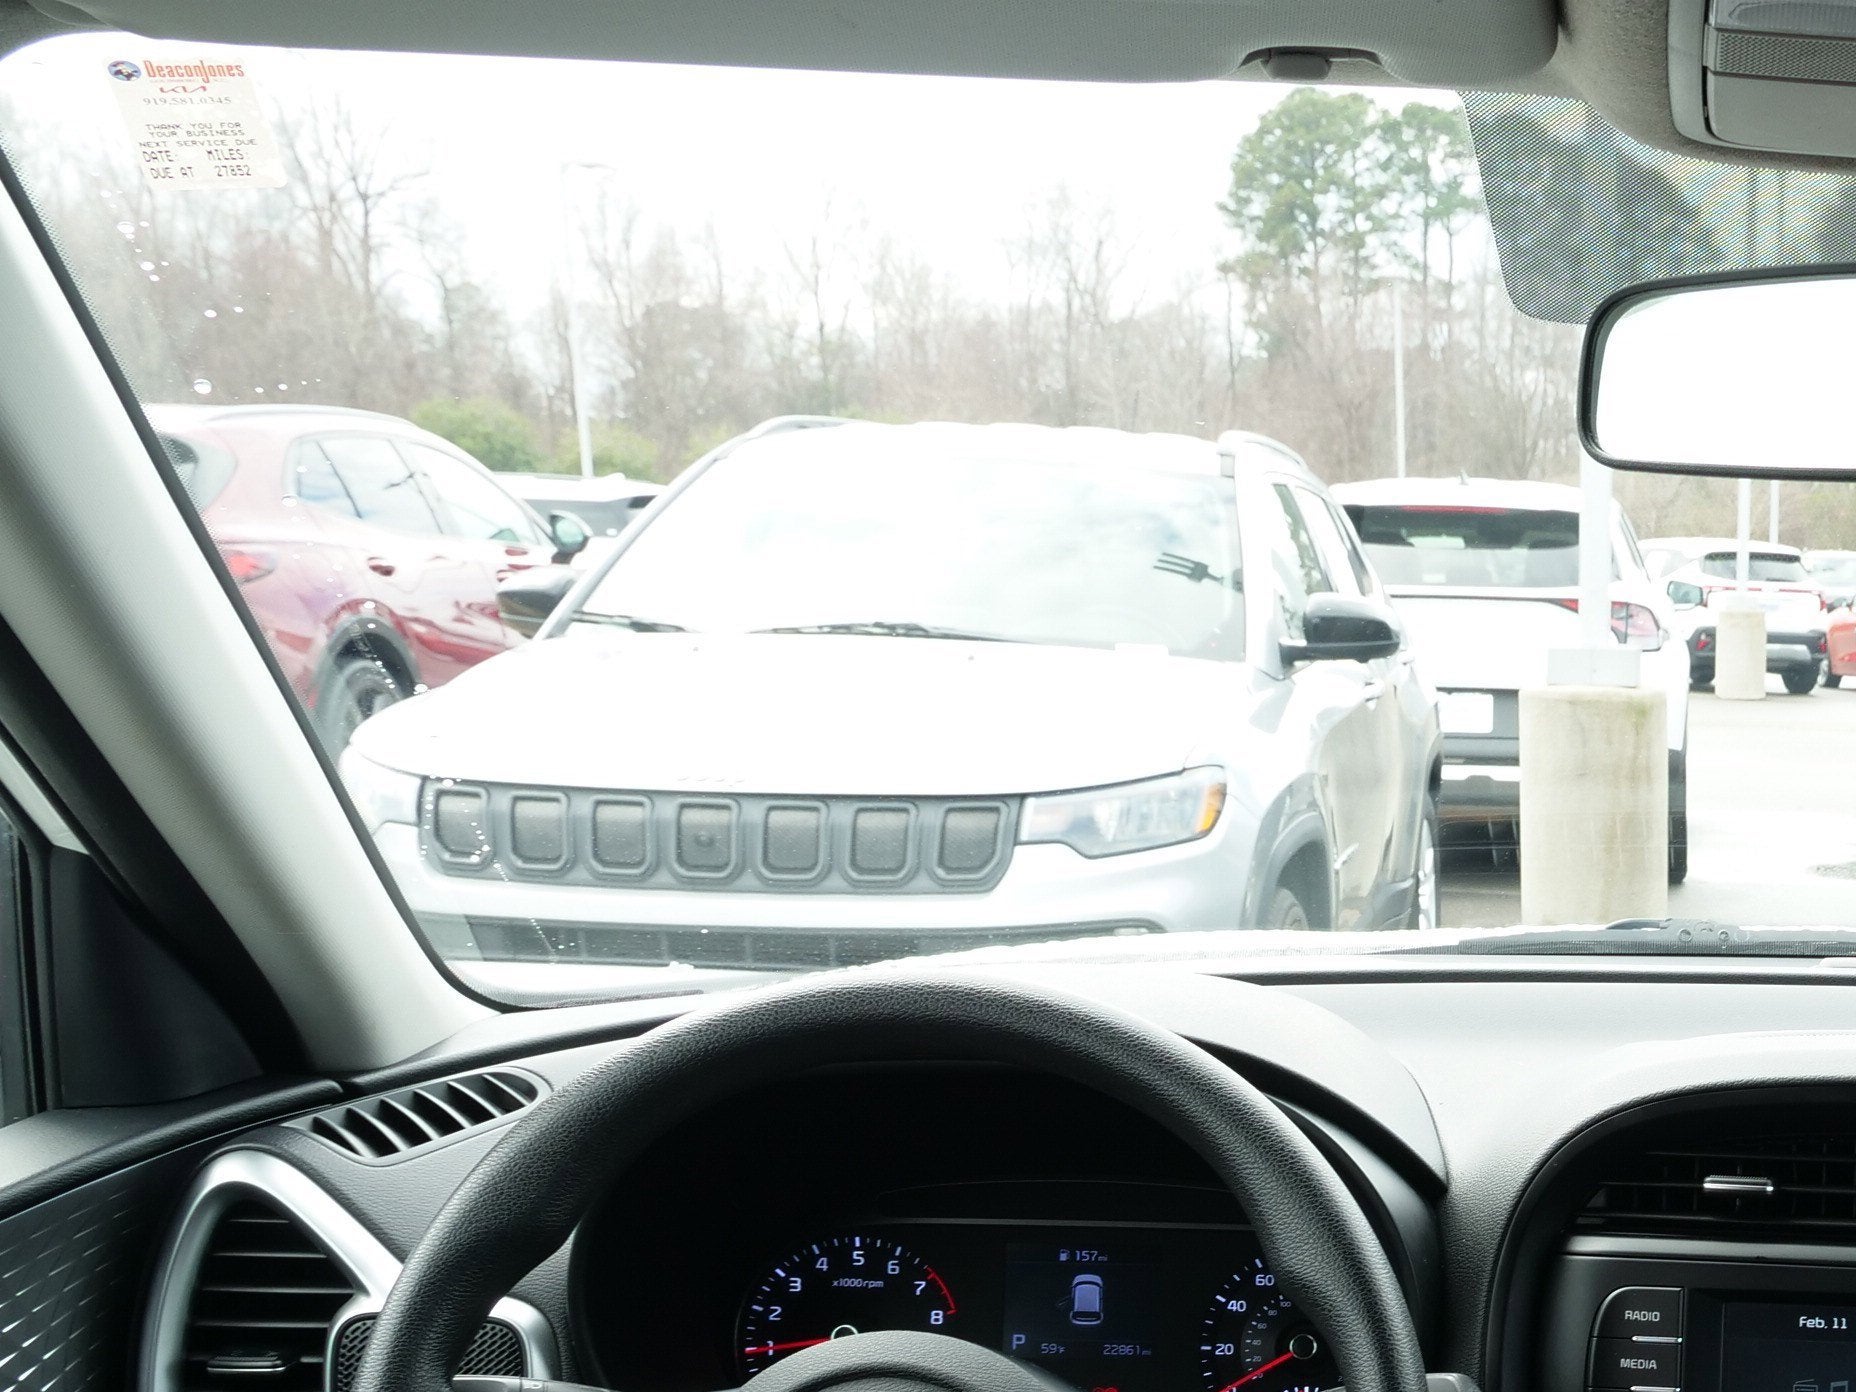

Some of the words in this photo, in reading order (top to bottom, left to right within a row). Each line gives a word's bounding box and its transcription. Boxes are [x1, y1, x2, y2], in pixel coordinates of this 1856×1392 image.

[187, 129, 245, 137] BUSINESS
[175, 139, 228, 147] SERVICE
[235, 138, 258, 146] DUE
[150, 167, 175, 179] DUE
[180, 166, 195, 178] AT
[816, 1257, 829, 1272] 4
[852, 1251, 865, 1266] 5
[887, 1260, 900, 1275] 6
[789, 1277, 802, 1292] 3
[1255, 1274, 1275, 1287] 60
[913, 1281, 926, 1296] 7
[1227, 1299, 1247, 1313] 40
[769, 1306, 782, 1321] 2
[930, 1310, 943, 1325] 8
[1624, 1310, 1660, 1322] RADIO
[1257, 1322, 1268, 1330] 60
[1799, 1316, 1829, 1329] Feb.
[1832, 1317, 1848, 1329] 11
[1012, 1334, 1026, 1350] P
[1215, 1343, 1235, 1356] 20
[1252, 1355, 1262, 1363] 20
[1620, 1358, 1657, 1370] MEDIA
